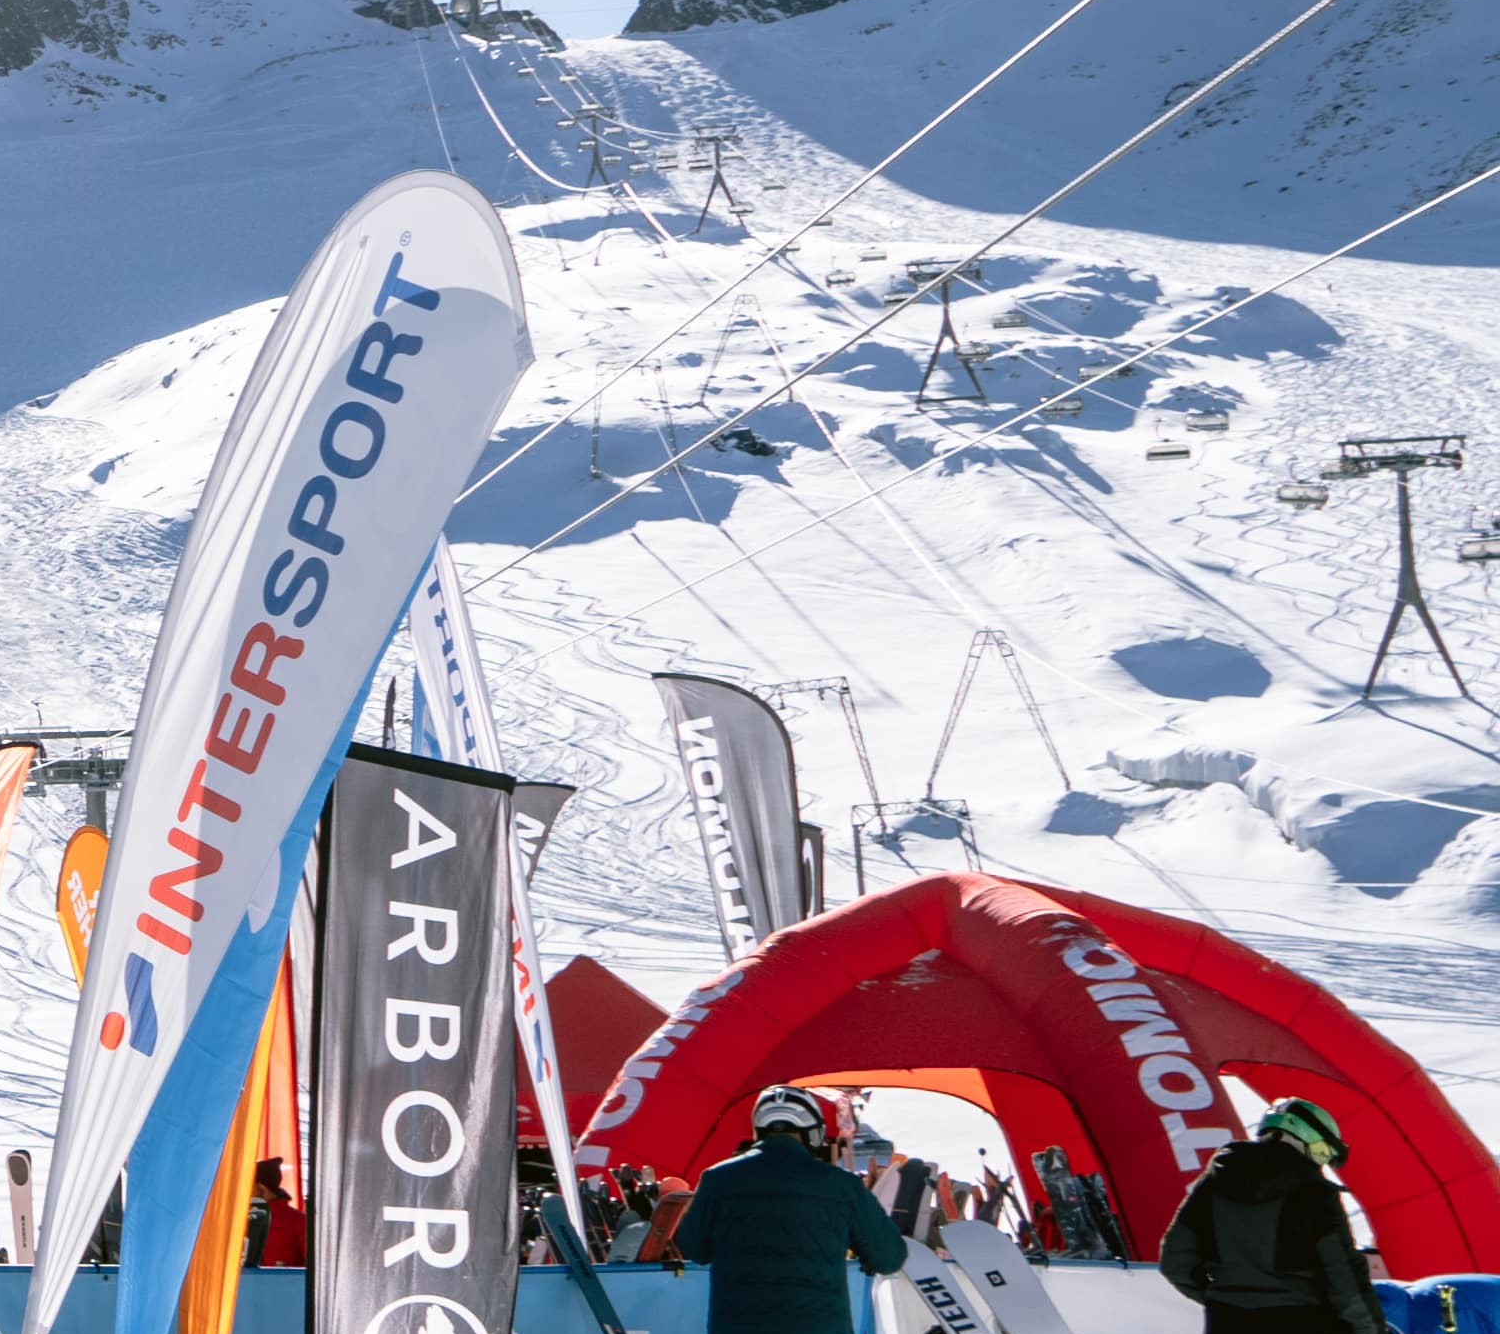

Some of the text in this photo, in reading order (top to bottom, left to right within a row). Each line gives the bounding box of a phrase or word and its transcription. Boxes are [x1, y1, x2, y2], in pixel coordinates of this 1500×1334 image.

[139, 251, 442, 955] INTERSPORT
[382, 788, 470, 1268] ARBOR
[1060, 941, 1236, 1172] TOMIC
